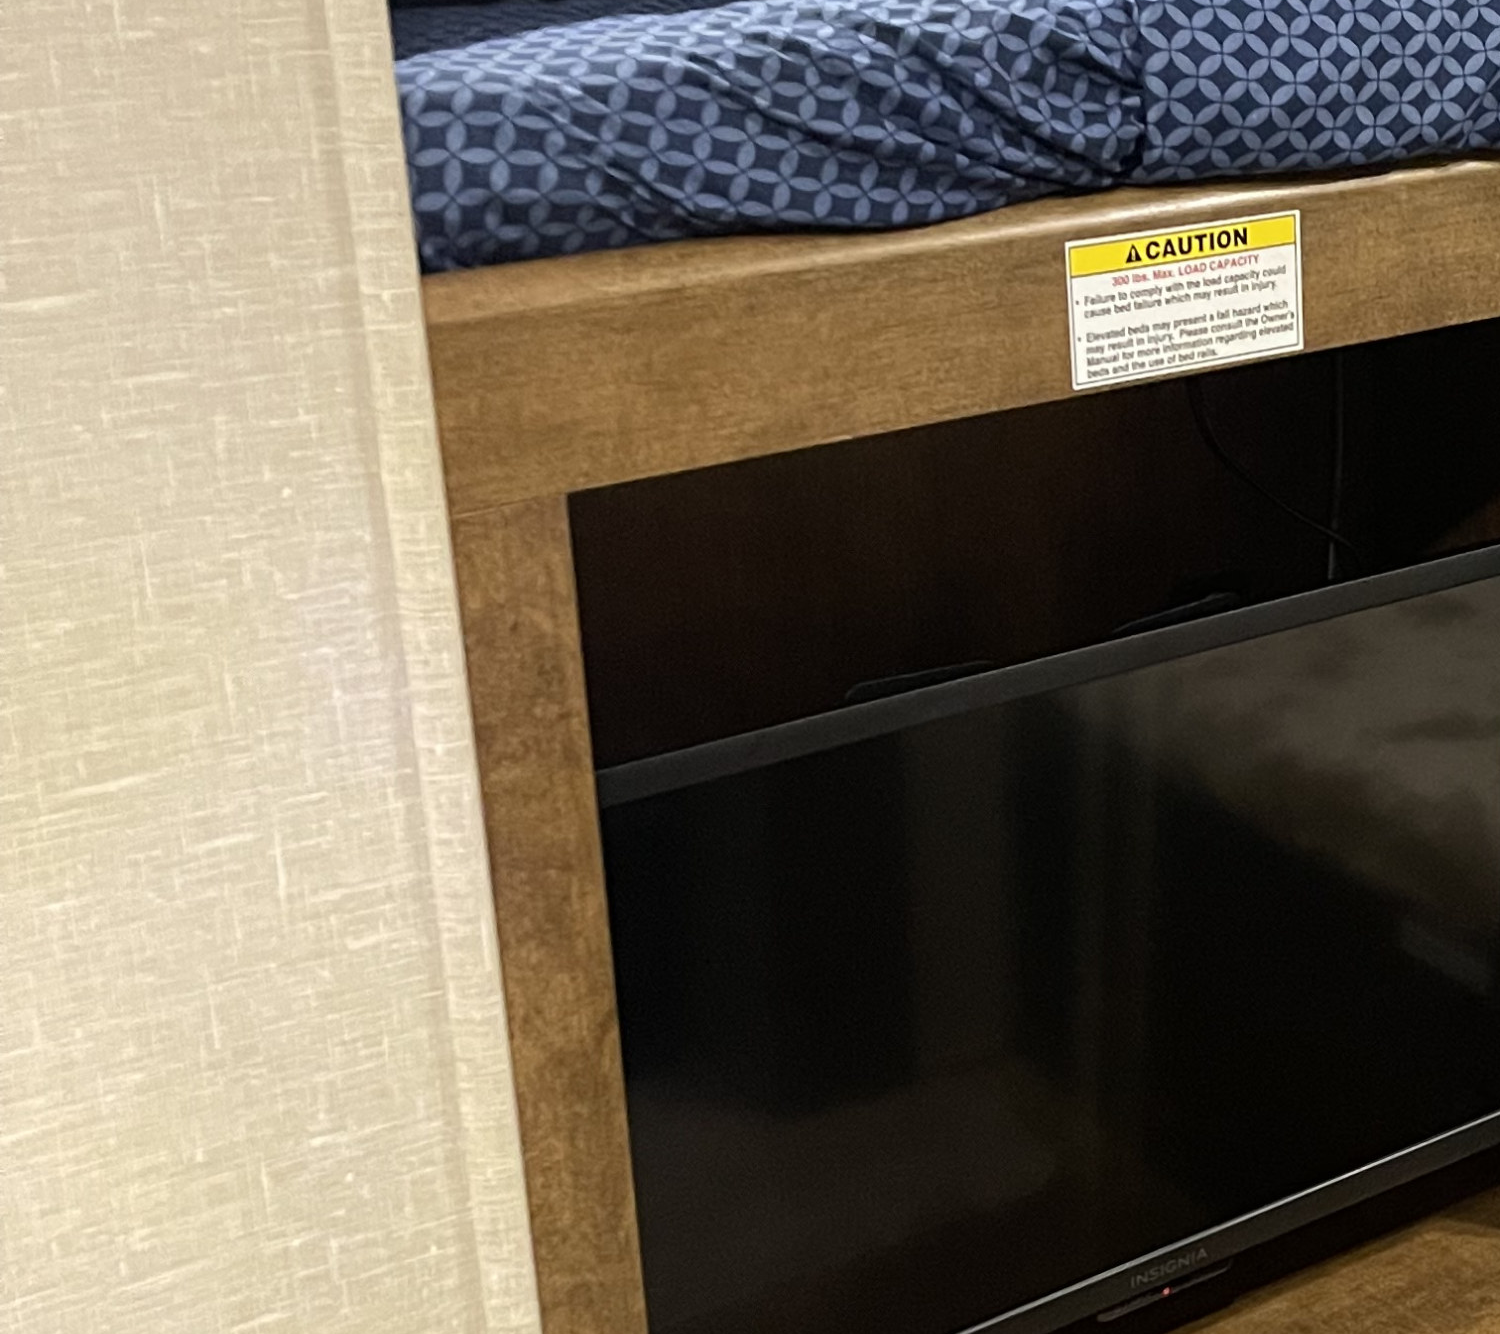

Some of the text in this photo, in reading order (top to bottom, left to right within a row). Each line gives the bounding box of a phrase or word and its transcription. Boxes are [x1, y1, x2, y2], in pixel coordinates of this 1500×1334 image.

[1145, 227, 1247, 259] CAUTION
[1083, 264, 1286, 306] Failure to comply with the load capacity could
[1111, 274, 1129, 286] 300
[1177, 262, 1207, 276] LOAD
[1208, 253, 1259, 271] CAPACITY
[1083, 306, 1111, 318] cause
[1113, 301, 1131, 313] bed
[1133, 298, 1162, 310] failure
[1164, 292, 1191, 305] which
[1192, 290, 1211, 300] may
[1213, 283, 1238, 296] result
[1240, 283, 1249, 292] in
[1085, 299, 1288, 343] Elevated beds may present a fall hazard which
[1085, 345, 1104, 354] may
[1107, 337, 1133, 350] result
[1135, 337, 1145, 345] in
[1179, 326, 1208, 338] Please
[1210, 319, 1242, 333] consult
[1244, 317, 1258, 327] the
[1260, 310, 1294, 324] Owner's
[1086, 321, 1293, 366] Manual for more information regarding elevated
[1086, 367, 1109, 378] beds
[1111, 362, 1129, 374] and
[1131, 361, 1146, 370] the
[1148, 357, 1164, 367] use
[1166, 354, 1176, 364] of
[1177, 350, 1195, 362] bed
[1131, 1248, 1208, 1287] INSIGNIA
